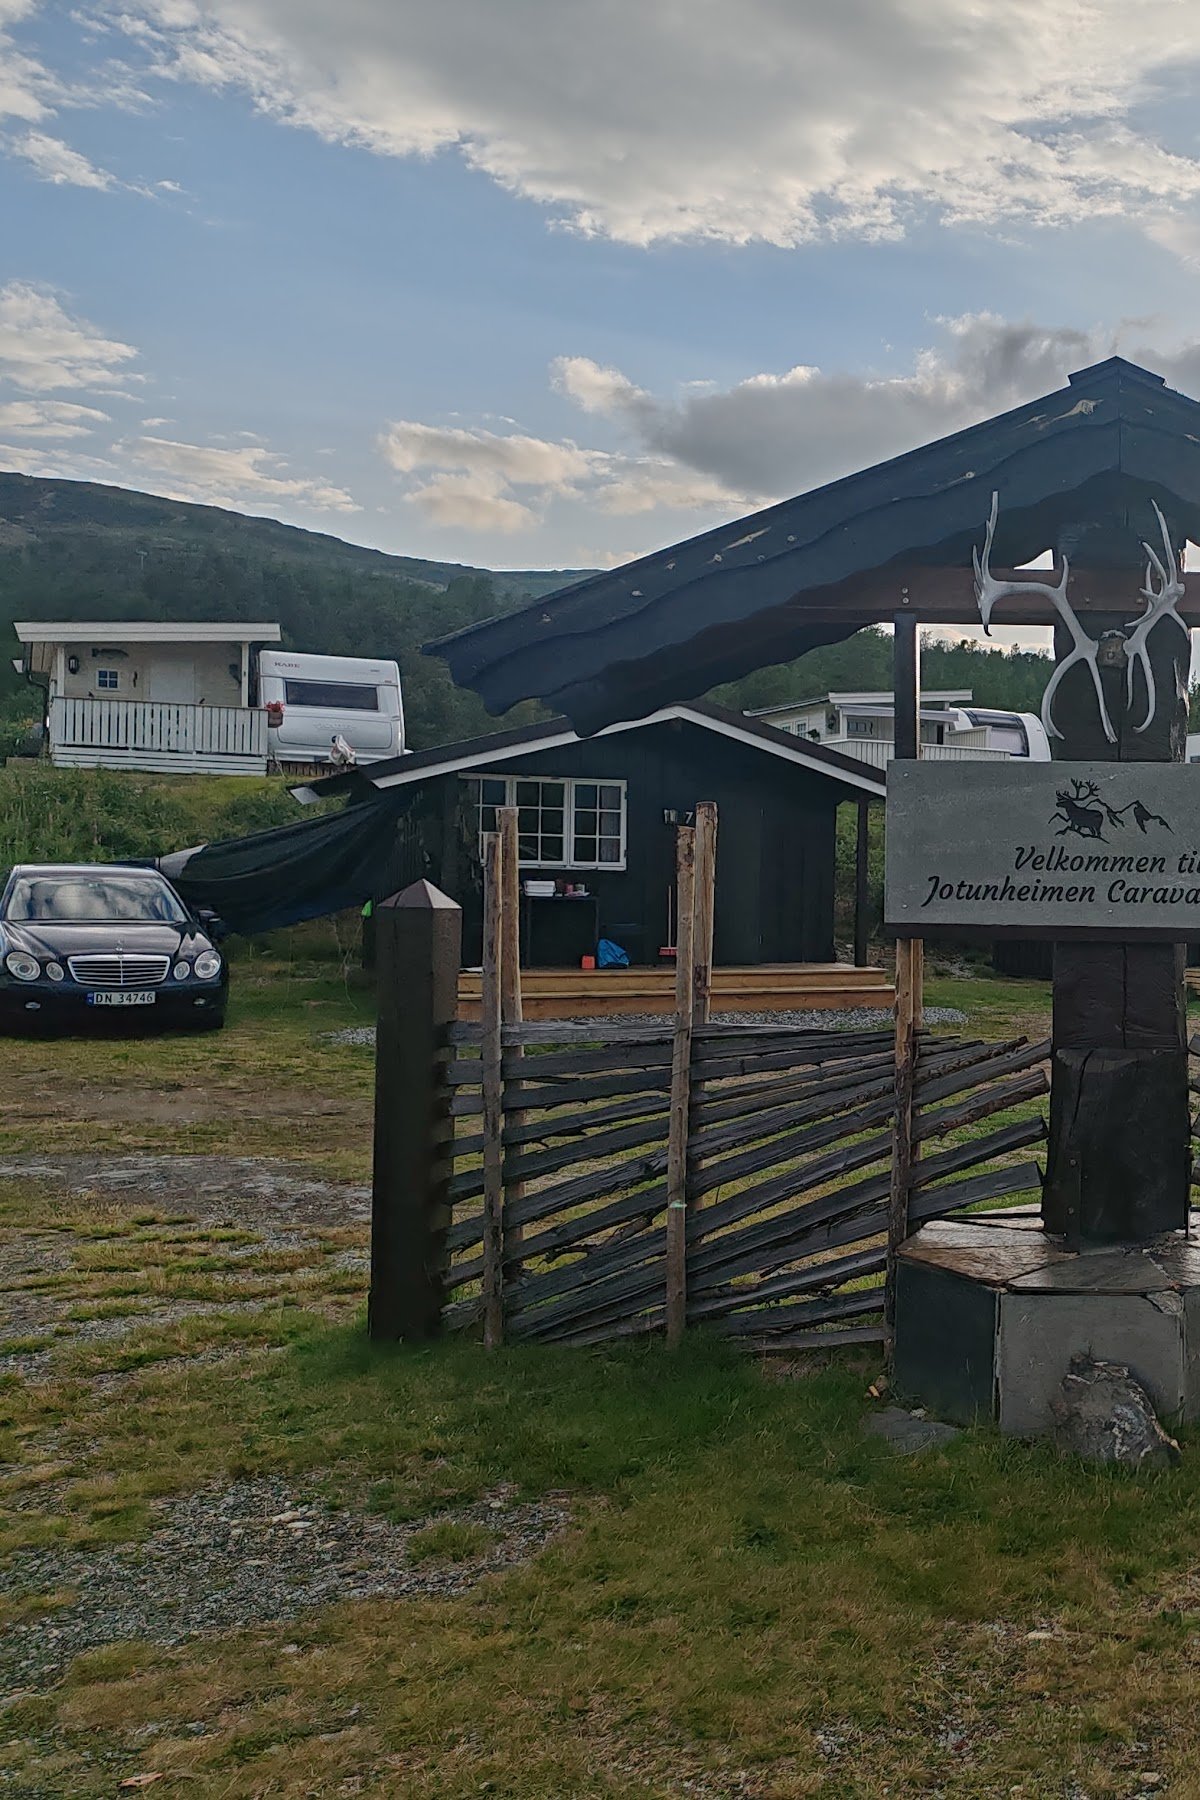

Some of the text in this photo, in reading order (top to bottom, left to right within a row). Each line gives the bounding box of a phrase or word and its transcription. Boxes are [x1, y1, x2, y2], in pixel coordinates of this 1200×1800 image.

[685, 811, 694, 824] 7
[1014, 846, 1167, 873] Velkommen
[920, 875, 1096, 908] Jotunheimen
[95, 993, 113, 1004] DN
[119, 993, 153, 1004] 34746
